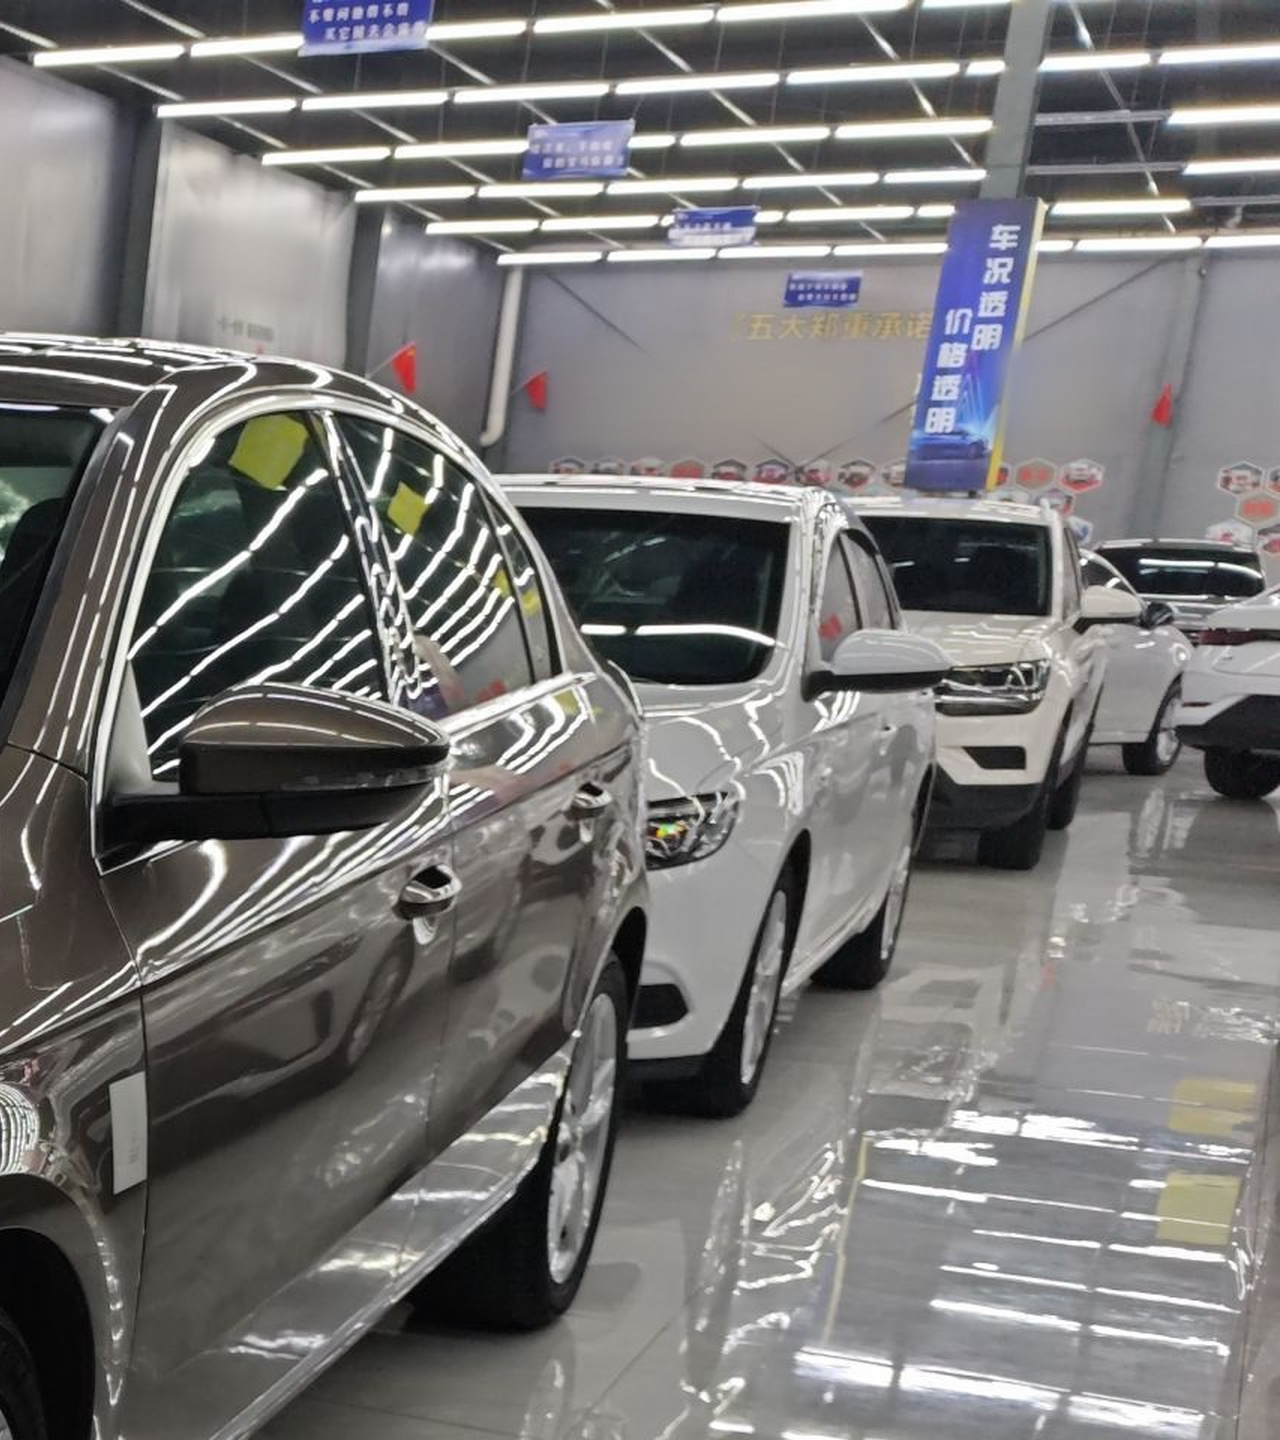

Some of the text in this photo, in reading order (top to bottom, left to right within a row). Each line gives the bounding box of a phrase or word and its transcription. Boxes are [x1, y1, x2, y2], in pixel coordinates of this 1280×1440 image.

[972, 224, 1022, 351] 车况透明
[924, 308, 974, 434] 价格透明
